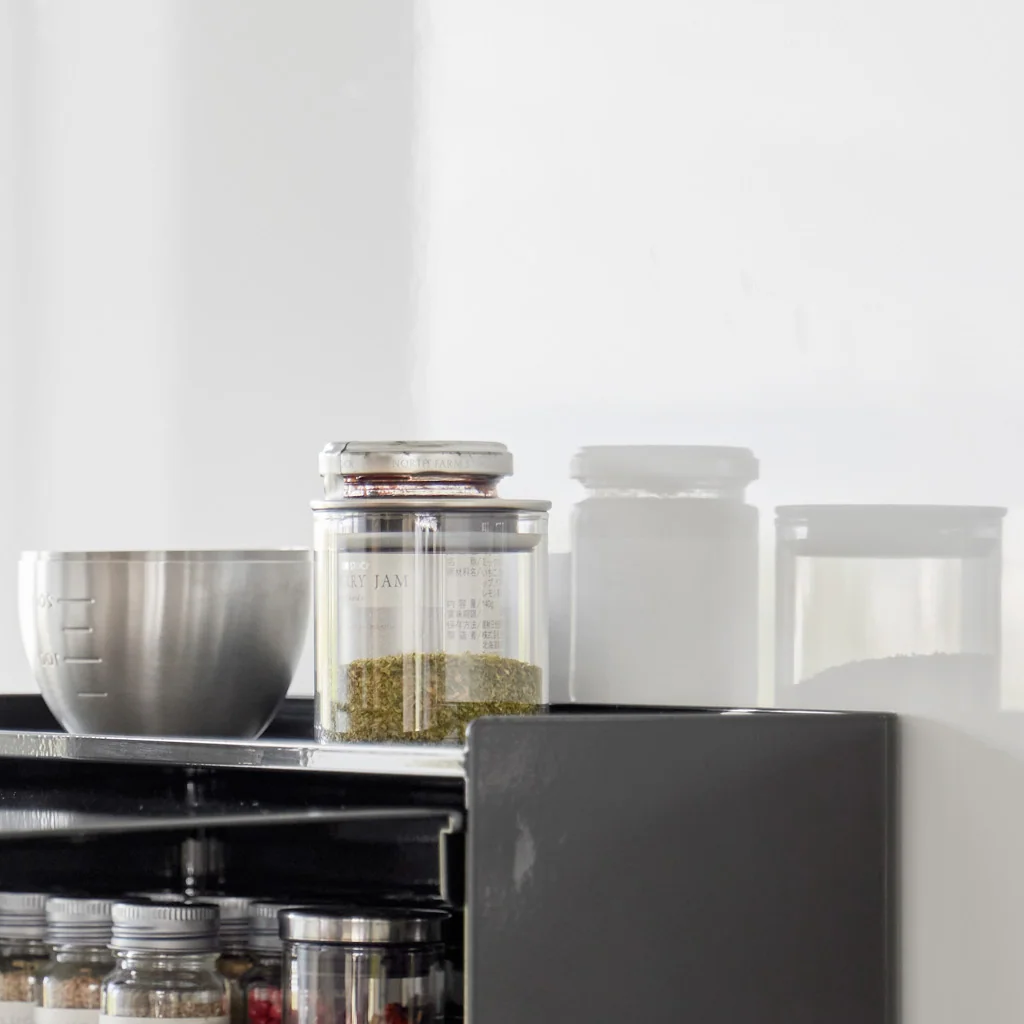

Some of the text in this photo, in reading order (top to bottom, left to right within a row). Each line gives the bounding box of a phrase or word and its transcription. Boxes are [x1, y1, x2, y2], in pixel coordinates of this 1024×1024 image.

[392, 458, 430, 469] NORTH
[347, 573, 409, 590] RY JAM
